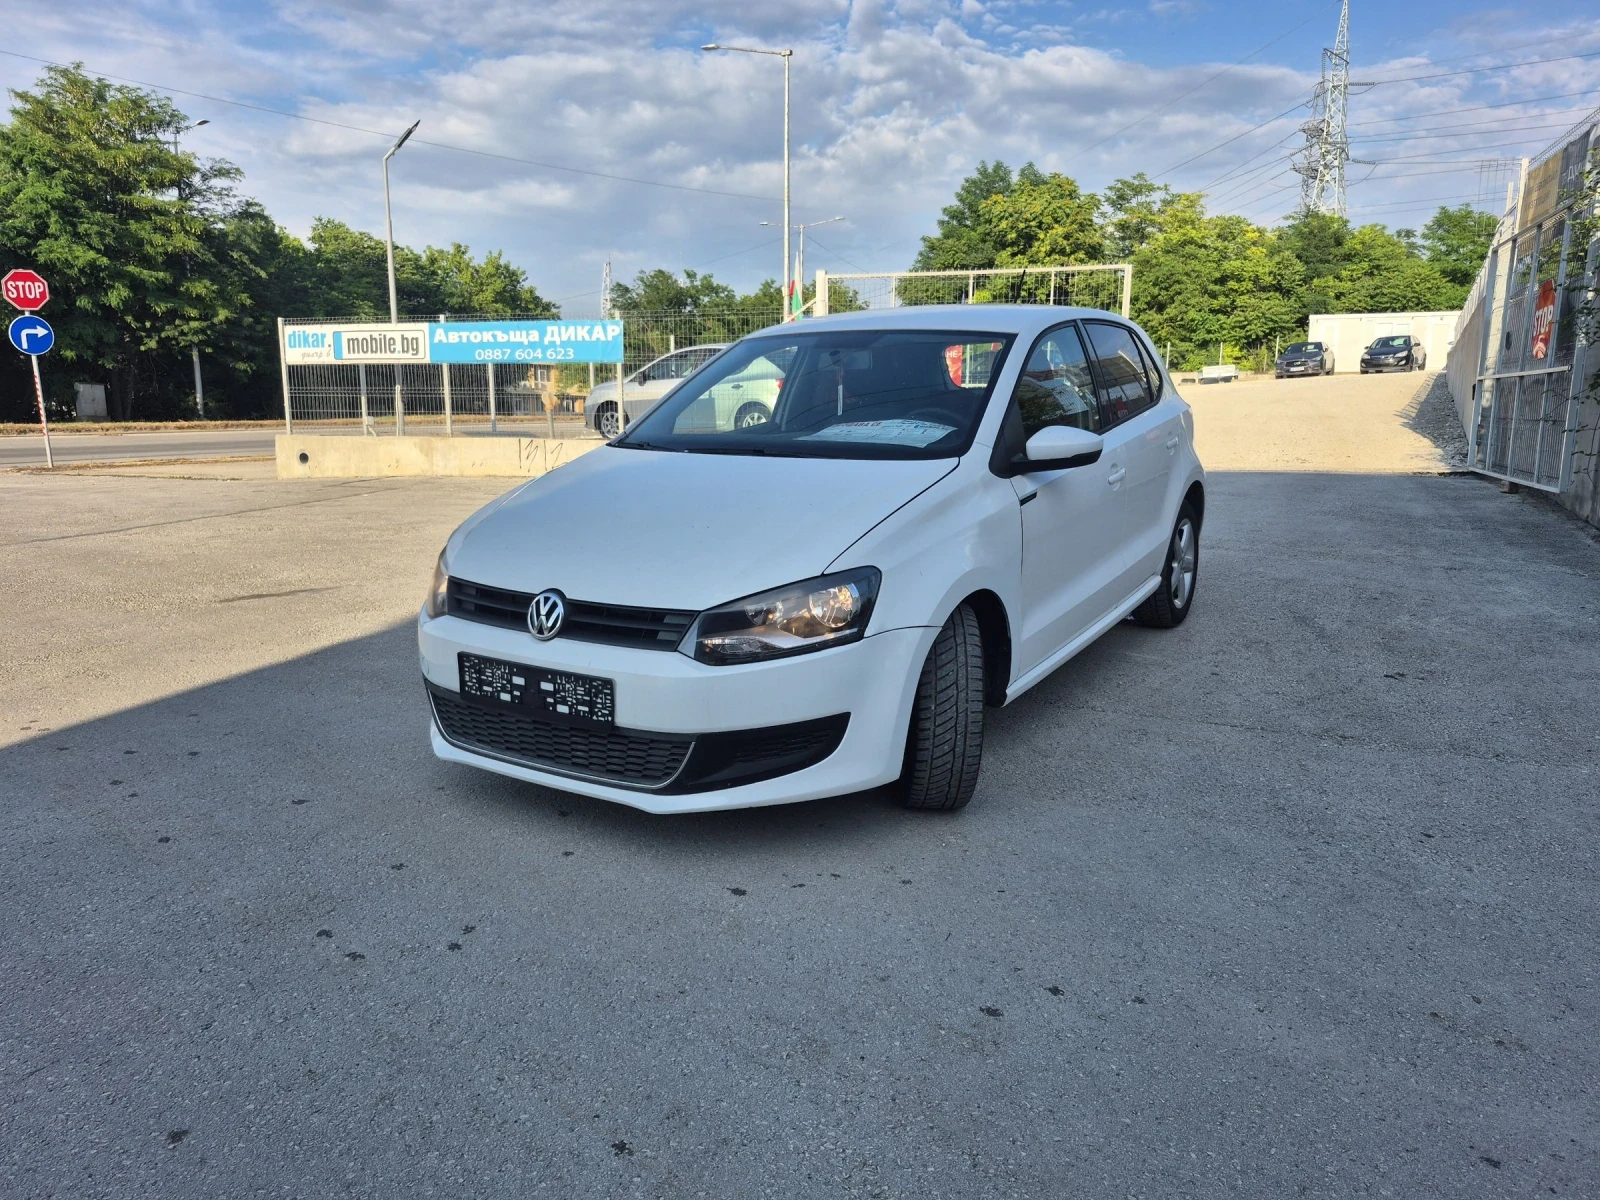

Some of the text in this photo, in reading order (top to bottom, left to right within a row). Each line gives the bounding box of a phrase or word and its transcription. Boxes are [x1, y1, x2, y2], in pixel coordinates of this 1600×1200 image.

[7, 281, 44, 299] STOP
[1533, 304, 1554, 336] STOP
[347, 333, 420, 356] mobile.bg
[433, 325, 621, 345] Автокъща ДИКАР
[475, 348, 574, 360] 0887 604 623
